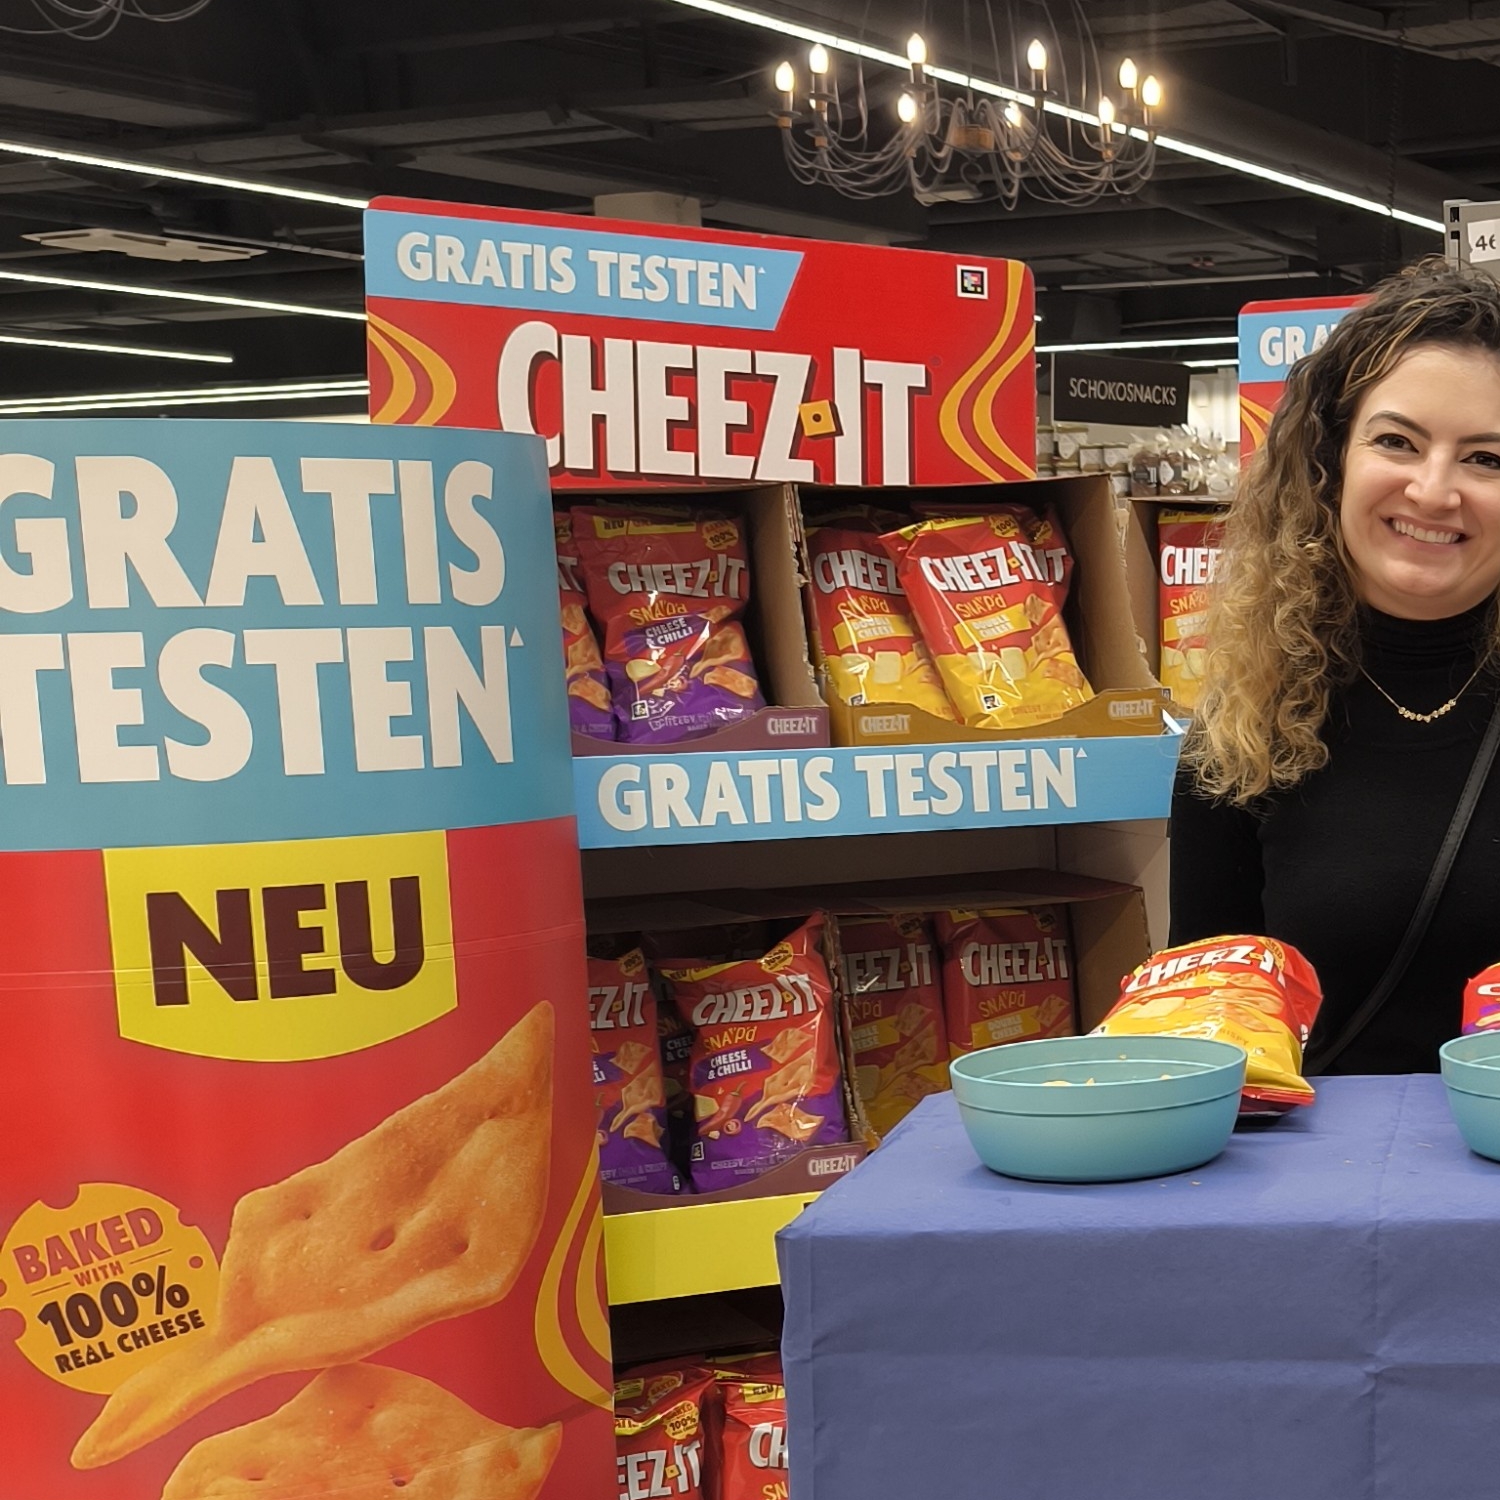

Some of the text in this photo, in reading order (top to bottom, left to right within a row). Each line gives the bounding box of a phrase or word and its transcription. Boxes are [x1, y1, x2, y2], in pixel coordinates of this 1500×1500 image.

[396, 232, 757, 310] GRATIS TESTEN
[1069, 377, 1177, 406] SCHOKOSNACKS
[0, 453, 505, 613] GRATIS
[0, 626, 514, 784] TESTEN
[598, 748, 1080, 831] GRATIS TESTEN
[145, 875, 424, 1006] NEU
[707, 1060, 752, 1080] & CHILLI
[710, 1050, 748, 1067] CHEESE
[13, 1207, 163, 1285] BAKED
[73, 1260, 124, 1288] WITH
[37, 1265, 190, 1347] 100%
[54, 1309, 206, 1374] REAL CHEESE
